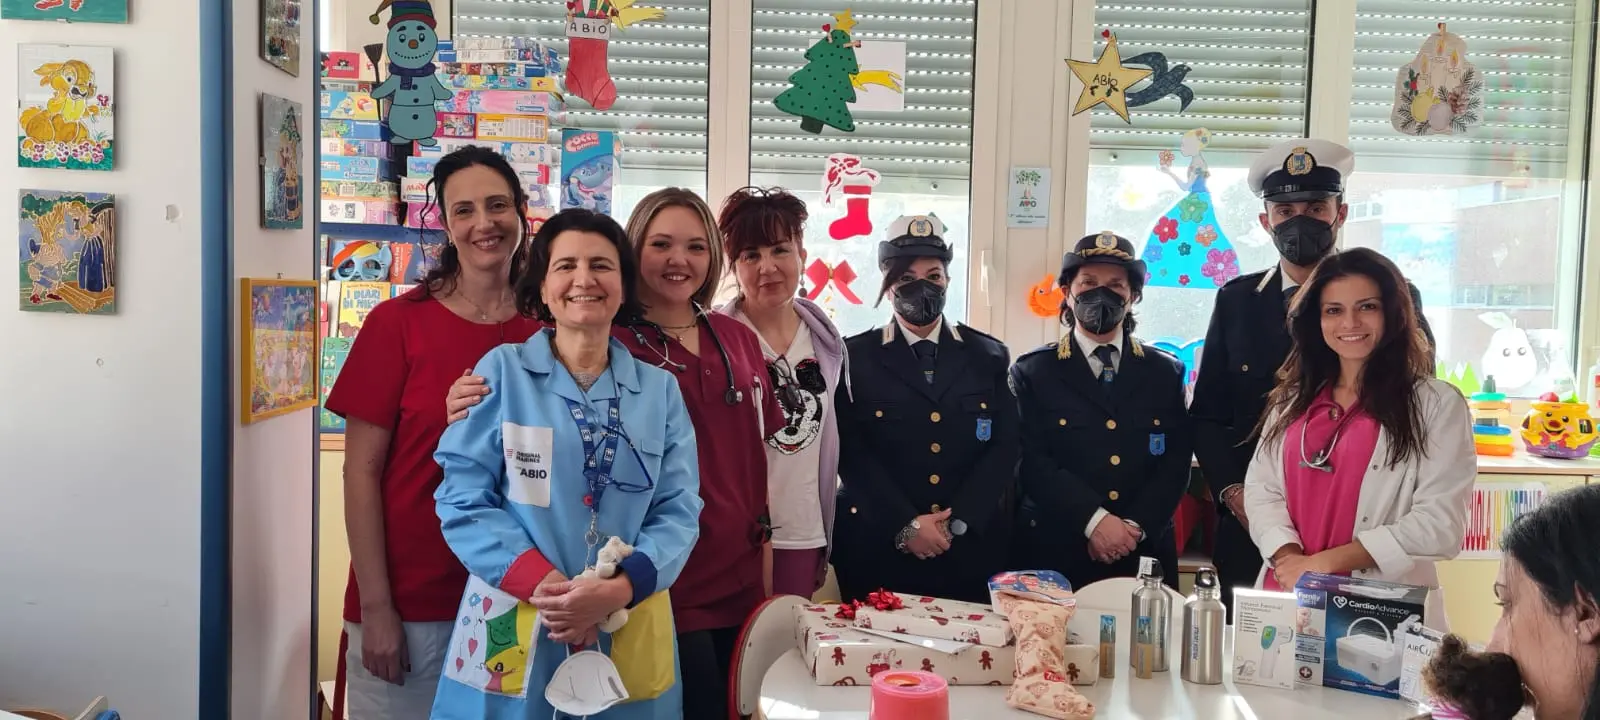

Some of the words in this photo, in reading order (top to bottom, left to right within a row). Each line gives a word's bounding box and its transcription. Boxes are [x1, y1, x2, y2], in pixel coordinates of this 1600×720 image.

[516, 451, 541, 459] ORIGINAL
[520, 468, 548, 480] ABIO
[1461, 489, 1491, 551] CUOLA
[1298, 591, 1321, 602] Family
[1348, 600, 1410, 616] CardioAdvance
